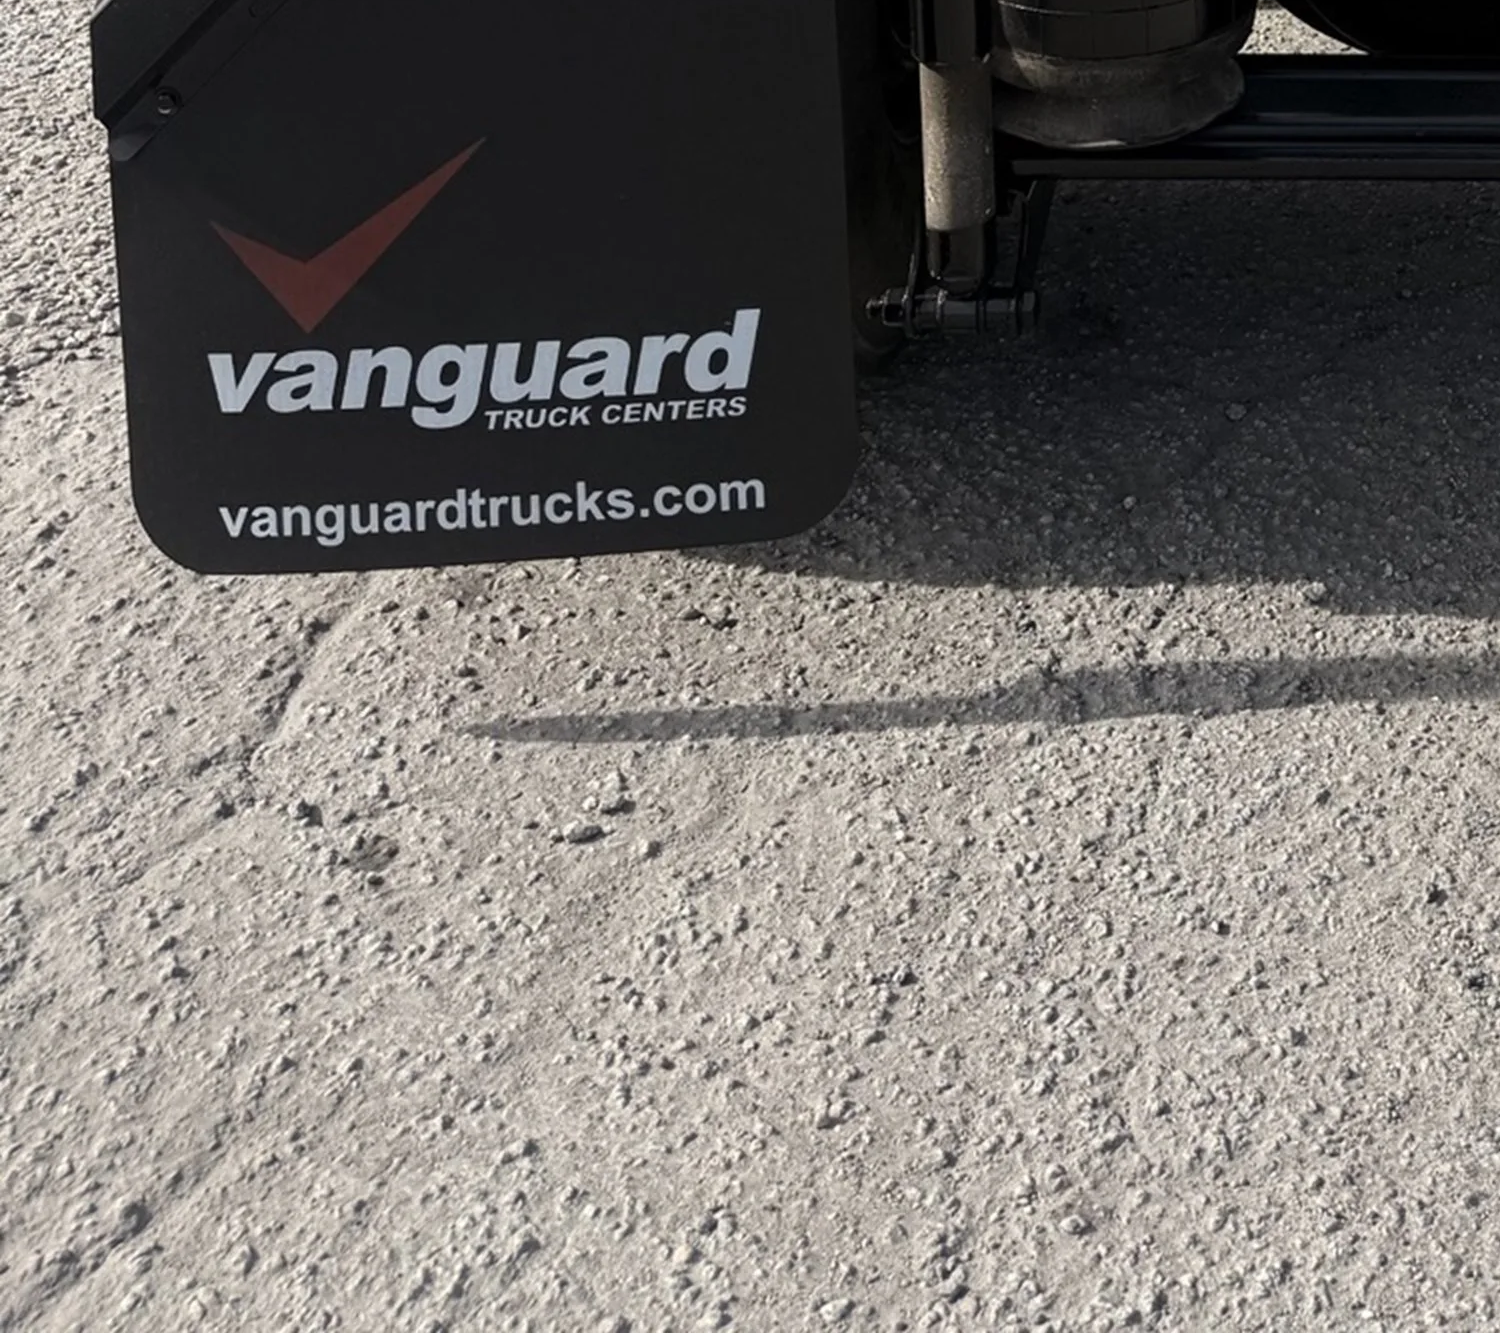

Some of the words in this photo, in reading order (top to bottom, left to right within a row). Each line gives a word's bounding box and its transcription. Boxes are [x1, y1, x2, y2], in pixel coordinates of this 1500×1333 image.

[207, 308, 761, 429] vanguard
[484, 405, 592, 431] TRUCK
[601, 396, 747, 425] CENTERS
[218, 479, 765, 547] vanguardtrucks.com
